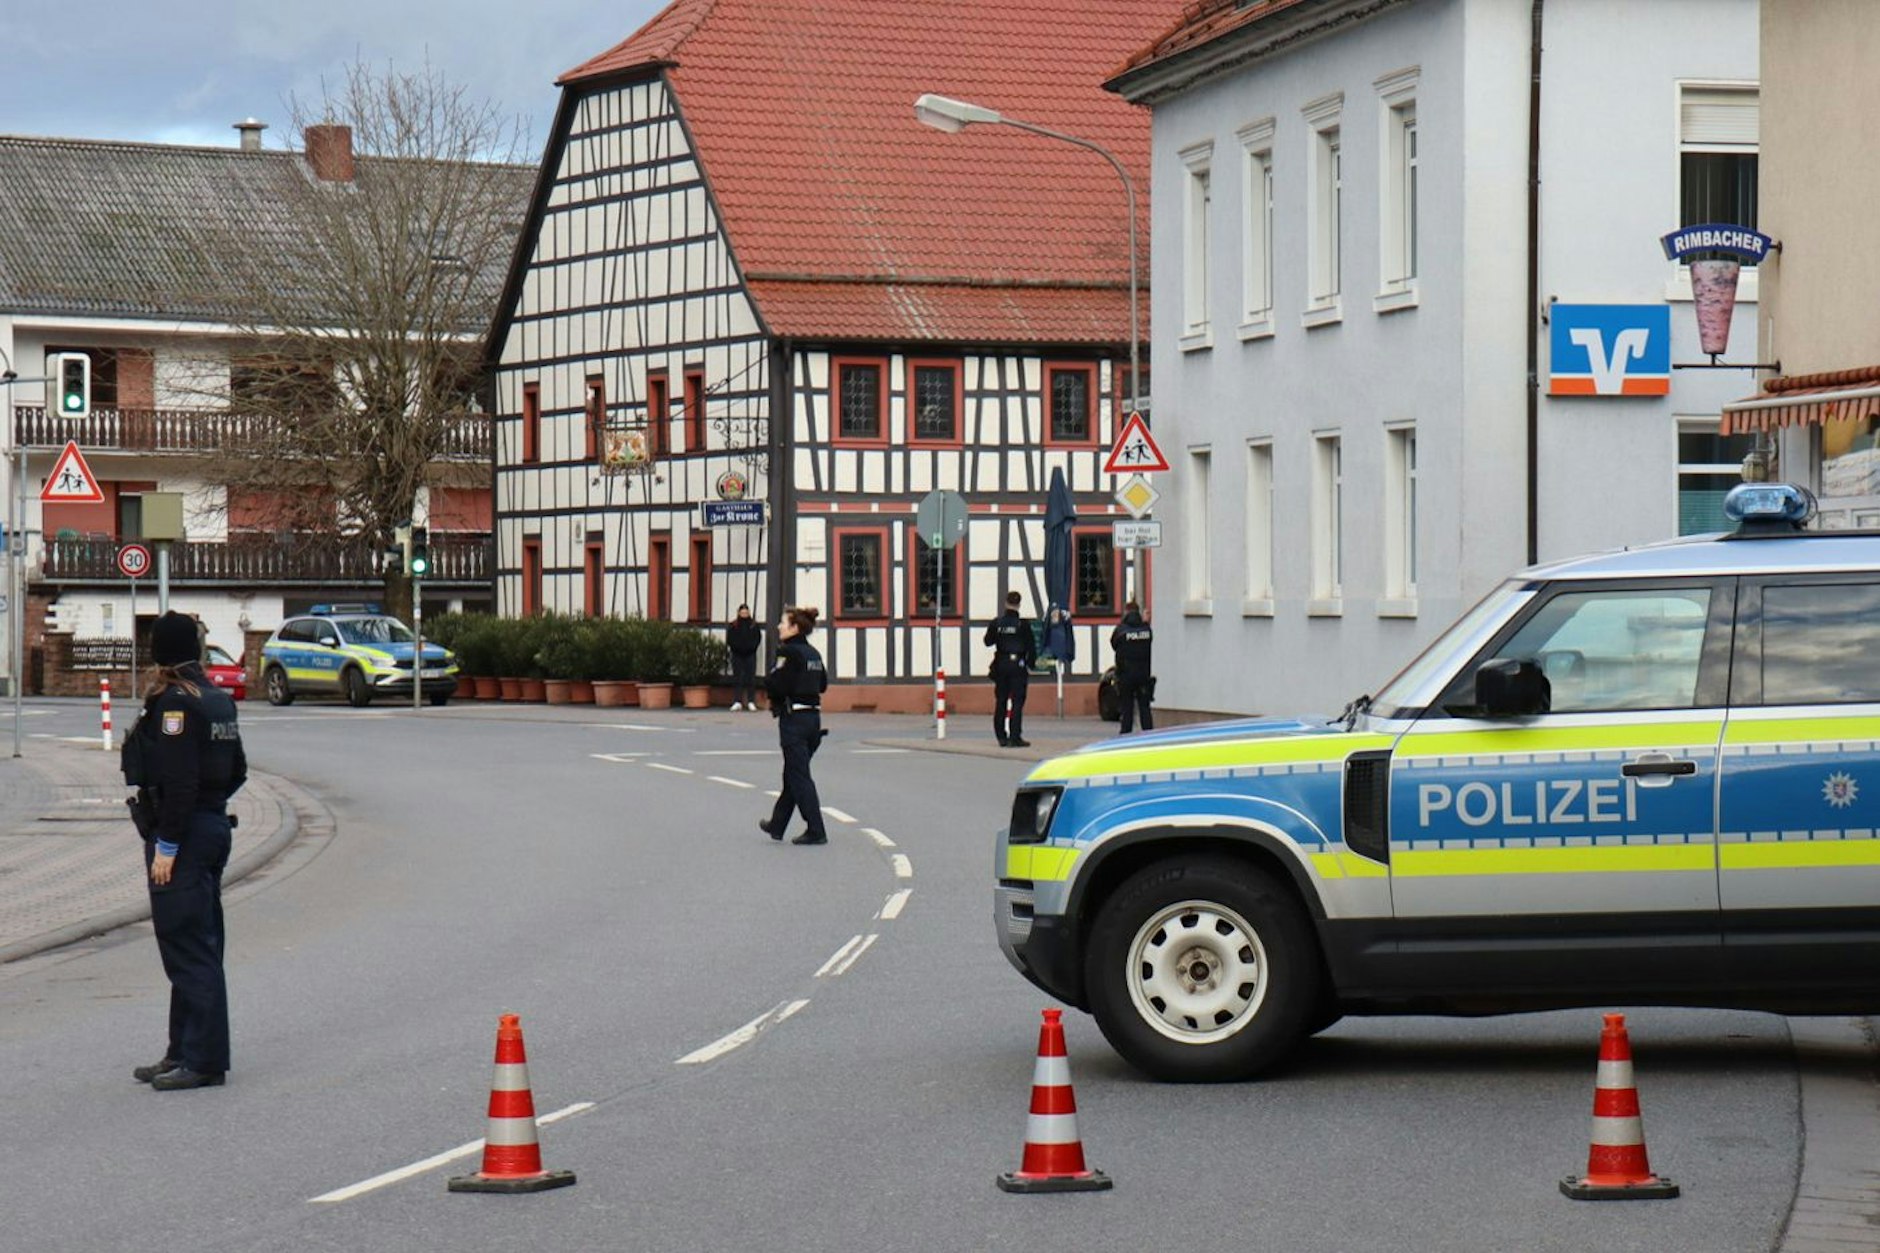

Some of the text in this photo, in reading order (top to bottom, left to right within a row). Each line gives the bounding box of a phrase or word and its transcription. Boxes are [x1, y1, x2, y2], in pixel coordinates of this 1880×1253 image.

[1674, 230, 1763, 253] RIMBACHER
[726, 511, 759, 522] Krone
[125, 553, 143, 567] 30
[1418, 779, 1637, 828] POLIZEI
